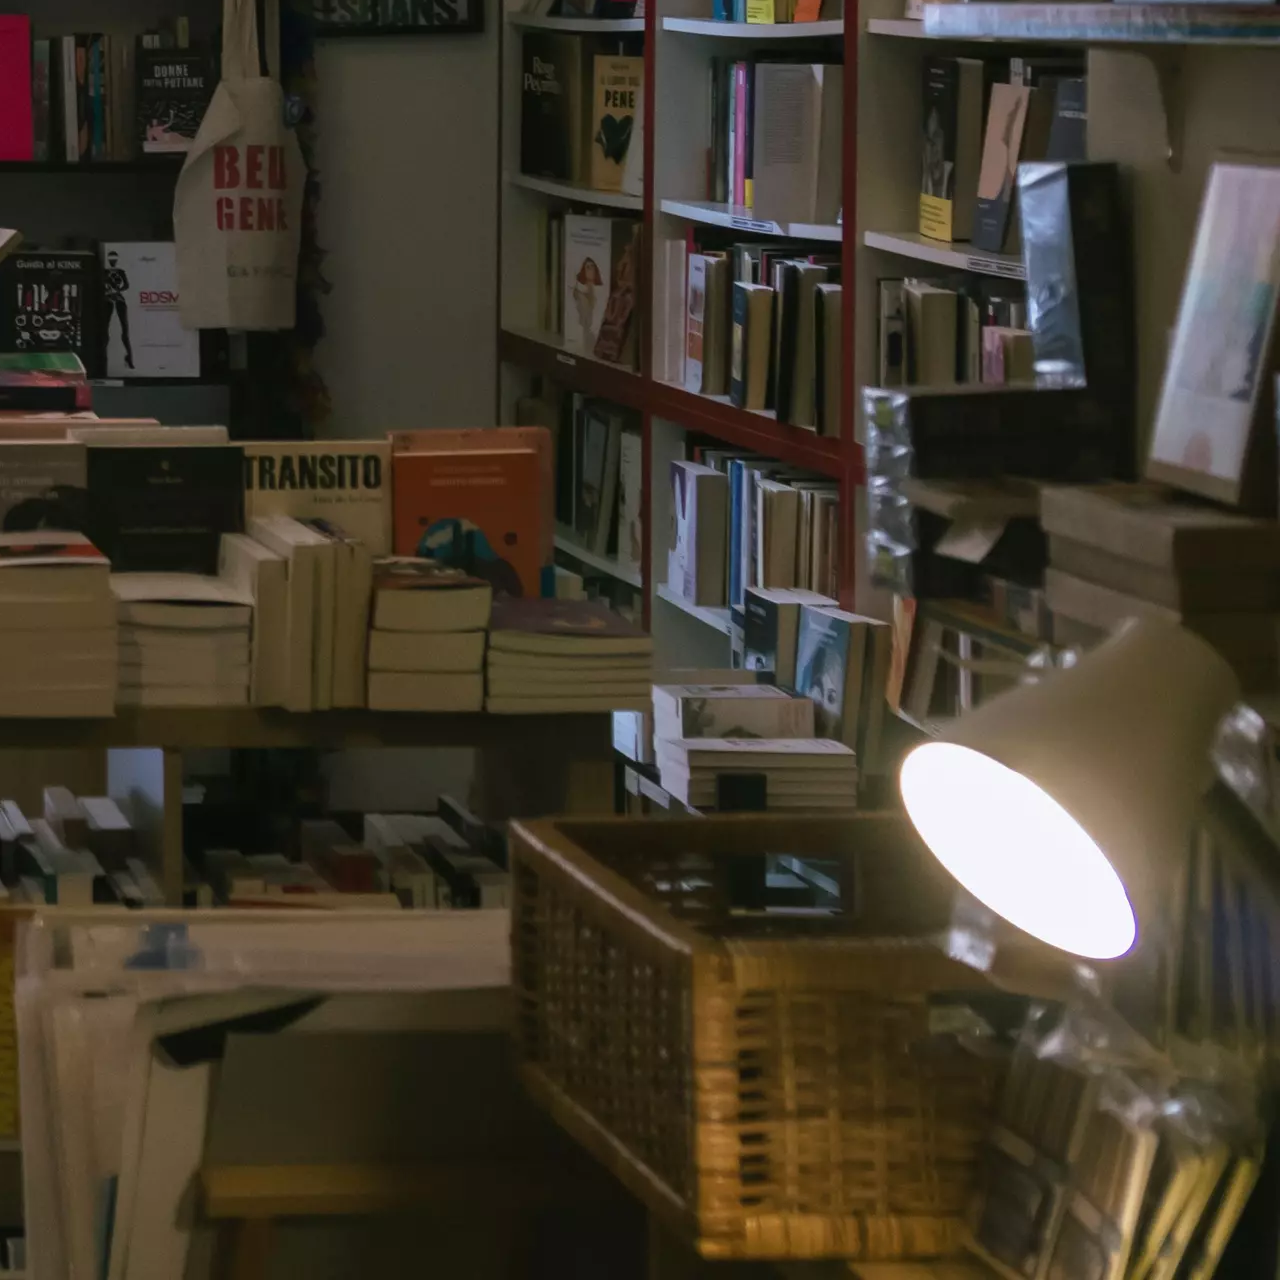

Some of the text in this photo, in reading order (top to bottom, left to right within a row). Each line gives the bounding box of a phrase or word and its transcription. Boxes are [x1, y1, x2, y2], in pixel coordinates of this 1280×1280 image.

[154, 64, 189, 78] DONNE
[605, 89, 635, 108] PENE
[16, 257, 44, 270] Guida
[57, 258, 82, 270] KINK
[139, 291, 180, 305] BDSM
[243, 454, 382, 491] TRANSITO
